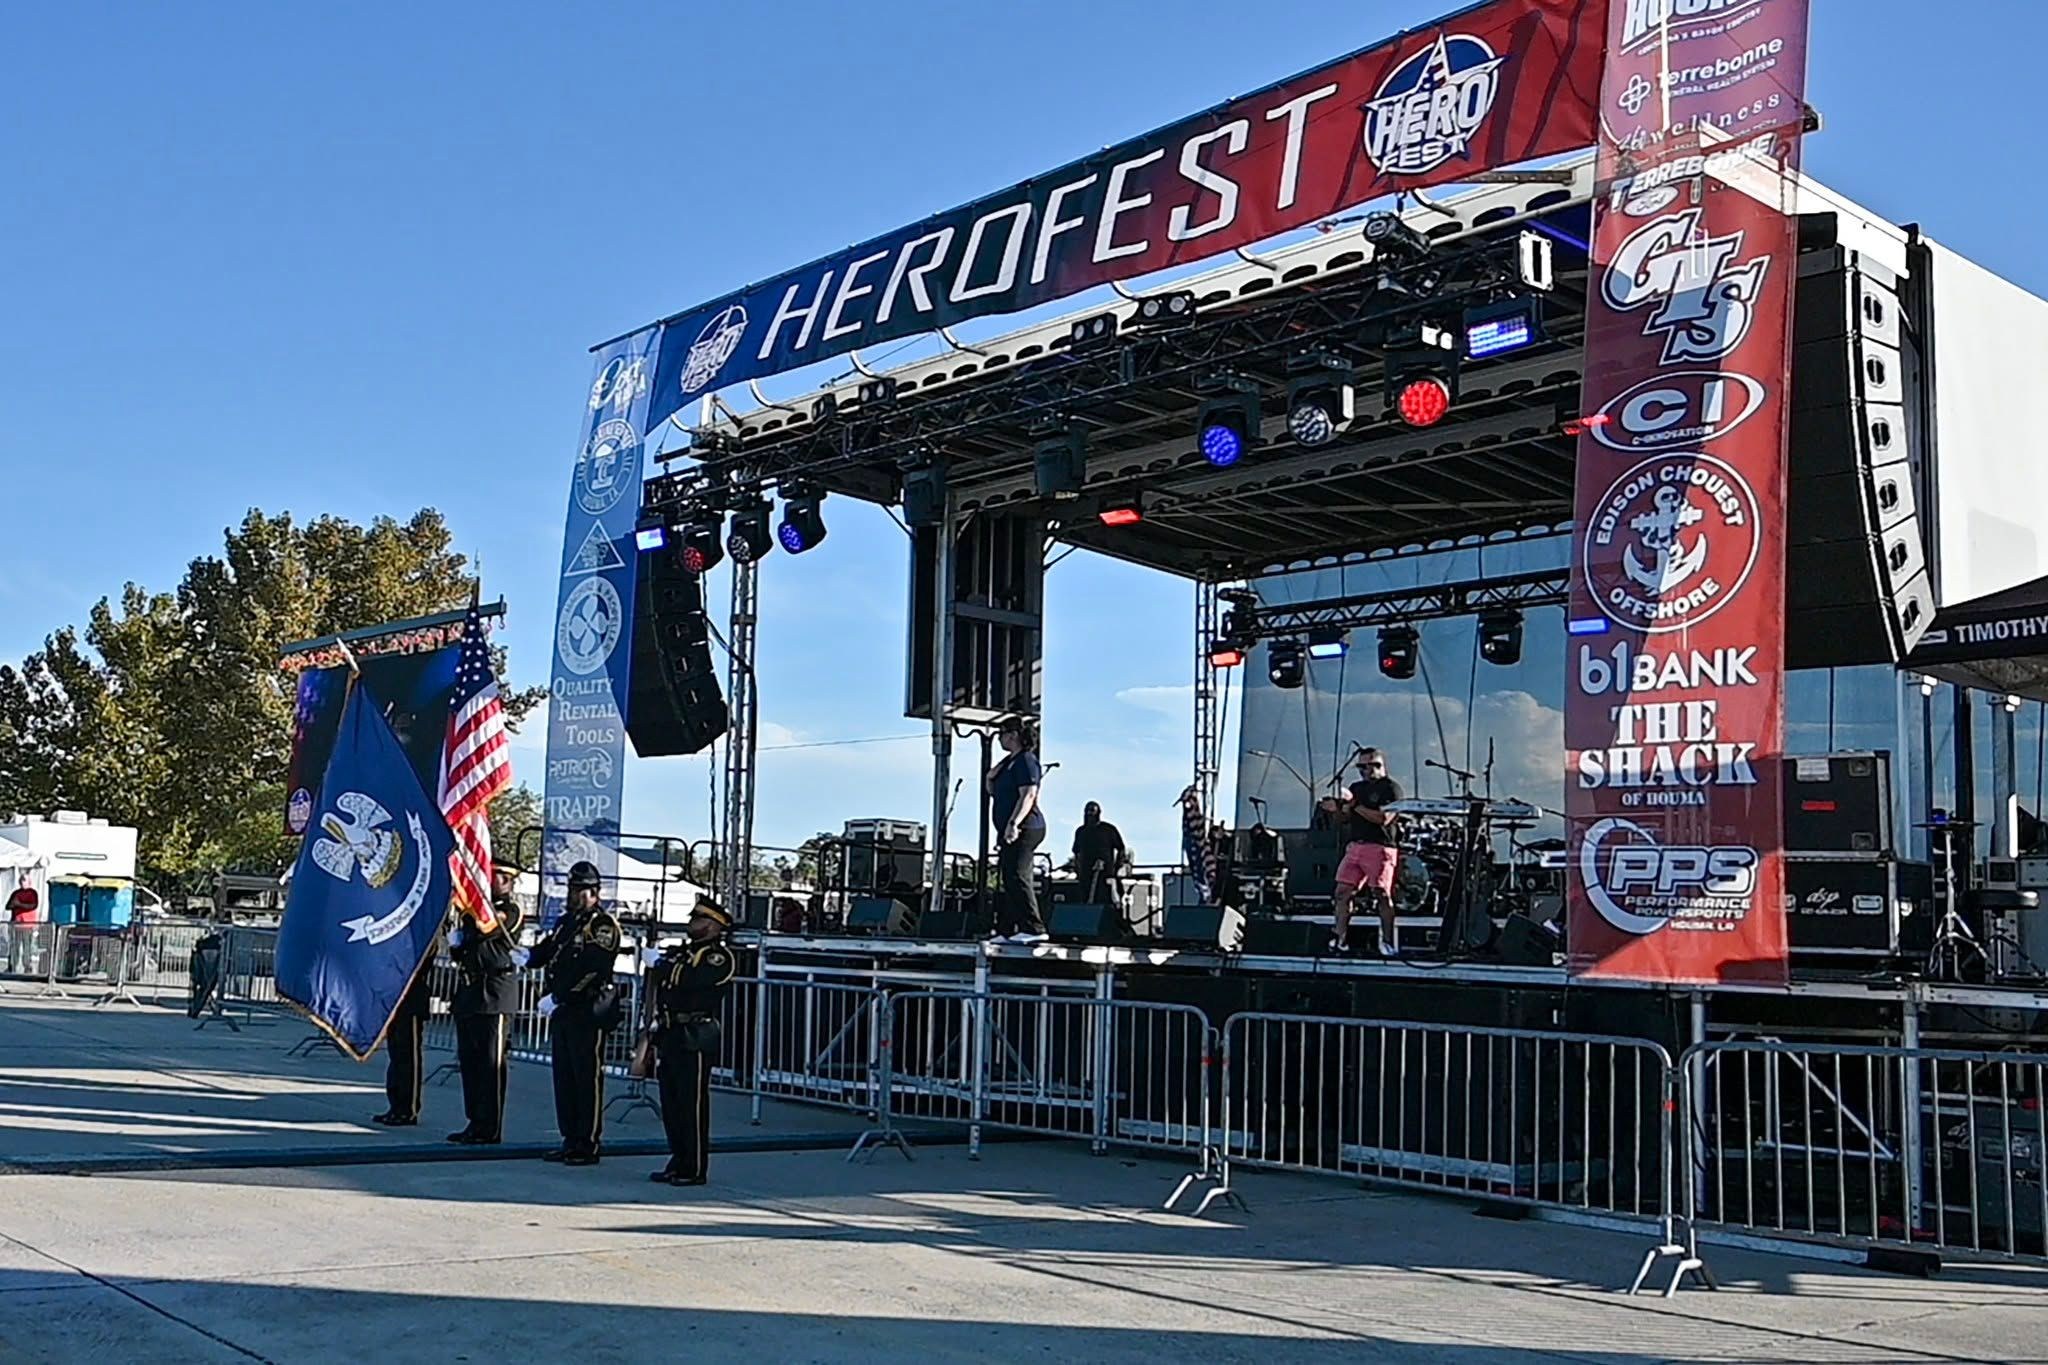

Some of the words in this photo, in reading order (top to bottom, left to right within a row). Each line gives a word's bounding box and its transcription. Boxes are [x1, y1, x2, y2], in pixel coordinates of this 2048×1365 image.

[1372, 71, 1491, 157] HERO
[1376, 131, 1467, 177] FEST
[757, 83, 1339, 359] HEROFEST
[1596, 471, 1655, 545] EDISON
[1659, 464, 1745, 526] CHOUEST
[1609, 577, 1721, 620] OFFSHORE
[1954, 614, 2048, 643] TIMOTHY
[552, 676, 614, 700] QUALITY
[558, 700, 617, 722] RENTAL
[1610, 700, 1718, 746] THE
[565, 724, 615, 746] TOOLS
[1578, 742, 1757, 789] SHACK
[546, 794, 612, 820] TRAPP
[1621, 792, 1643, 806] OF
[1645, 791, 1705, 806] HOUMA
[1608, 846, 1758, 896] PPS
[1624, 895, 1753, 909] PERFORMANCE
